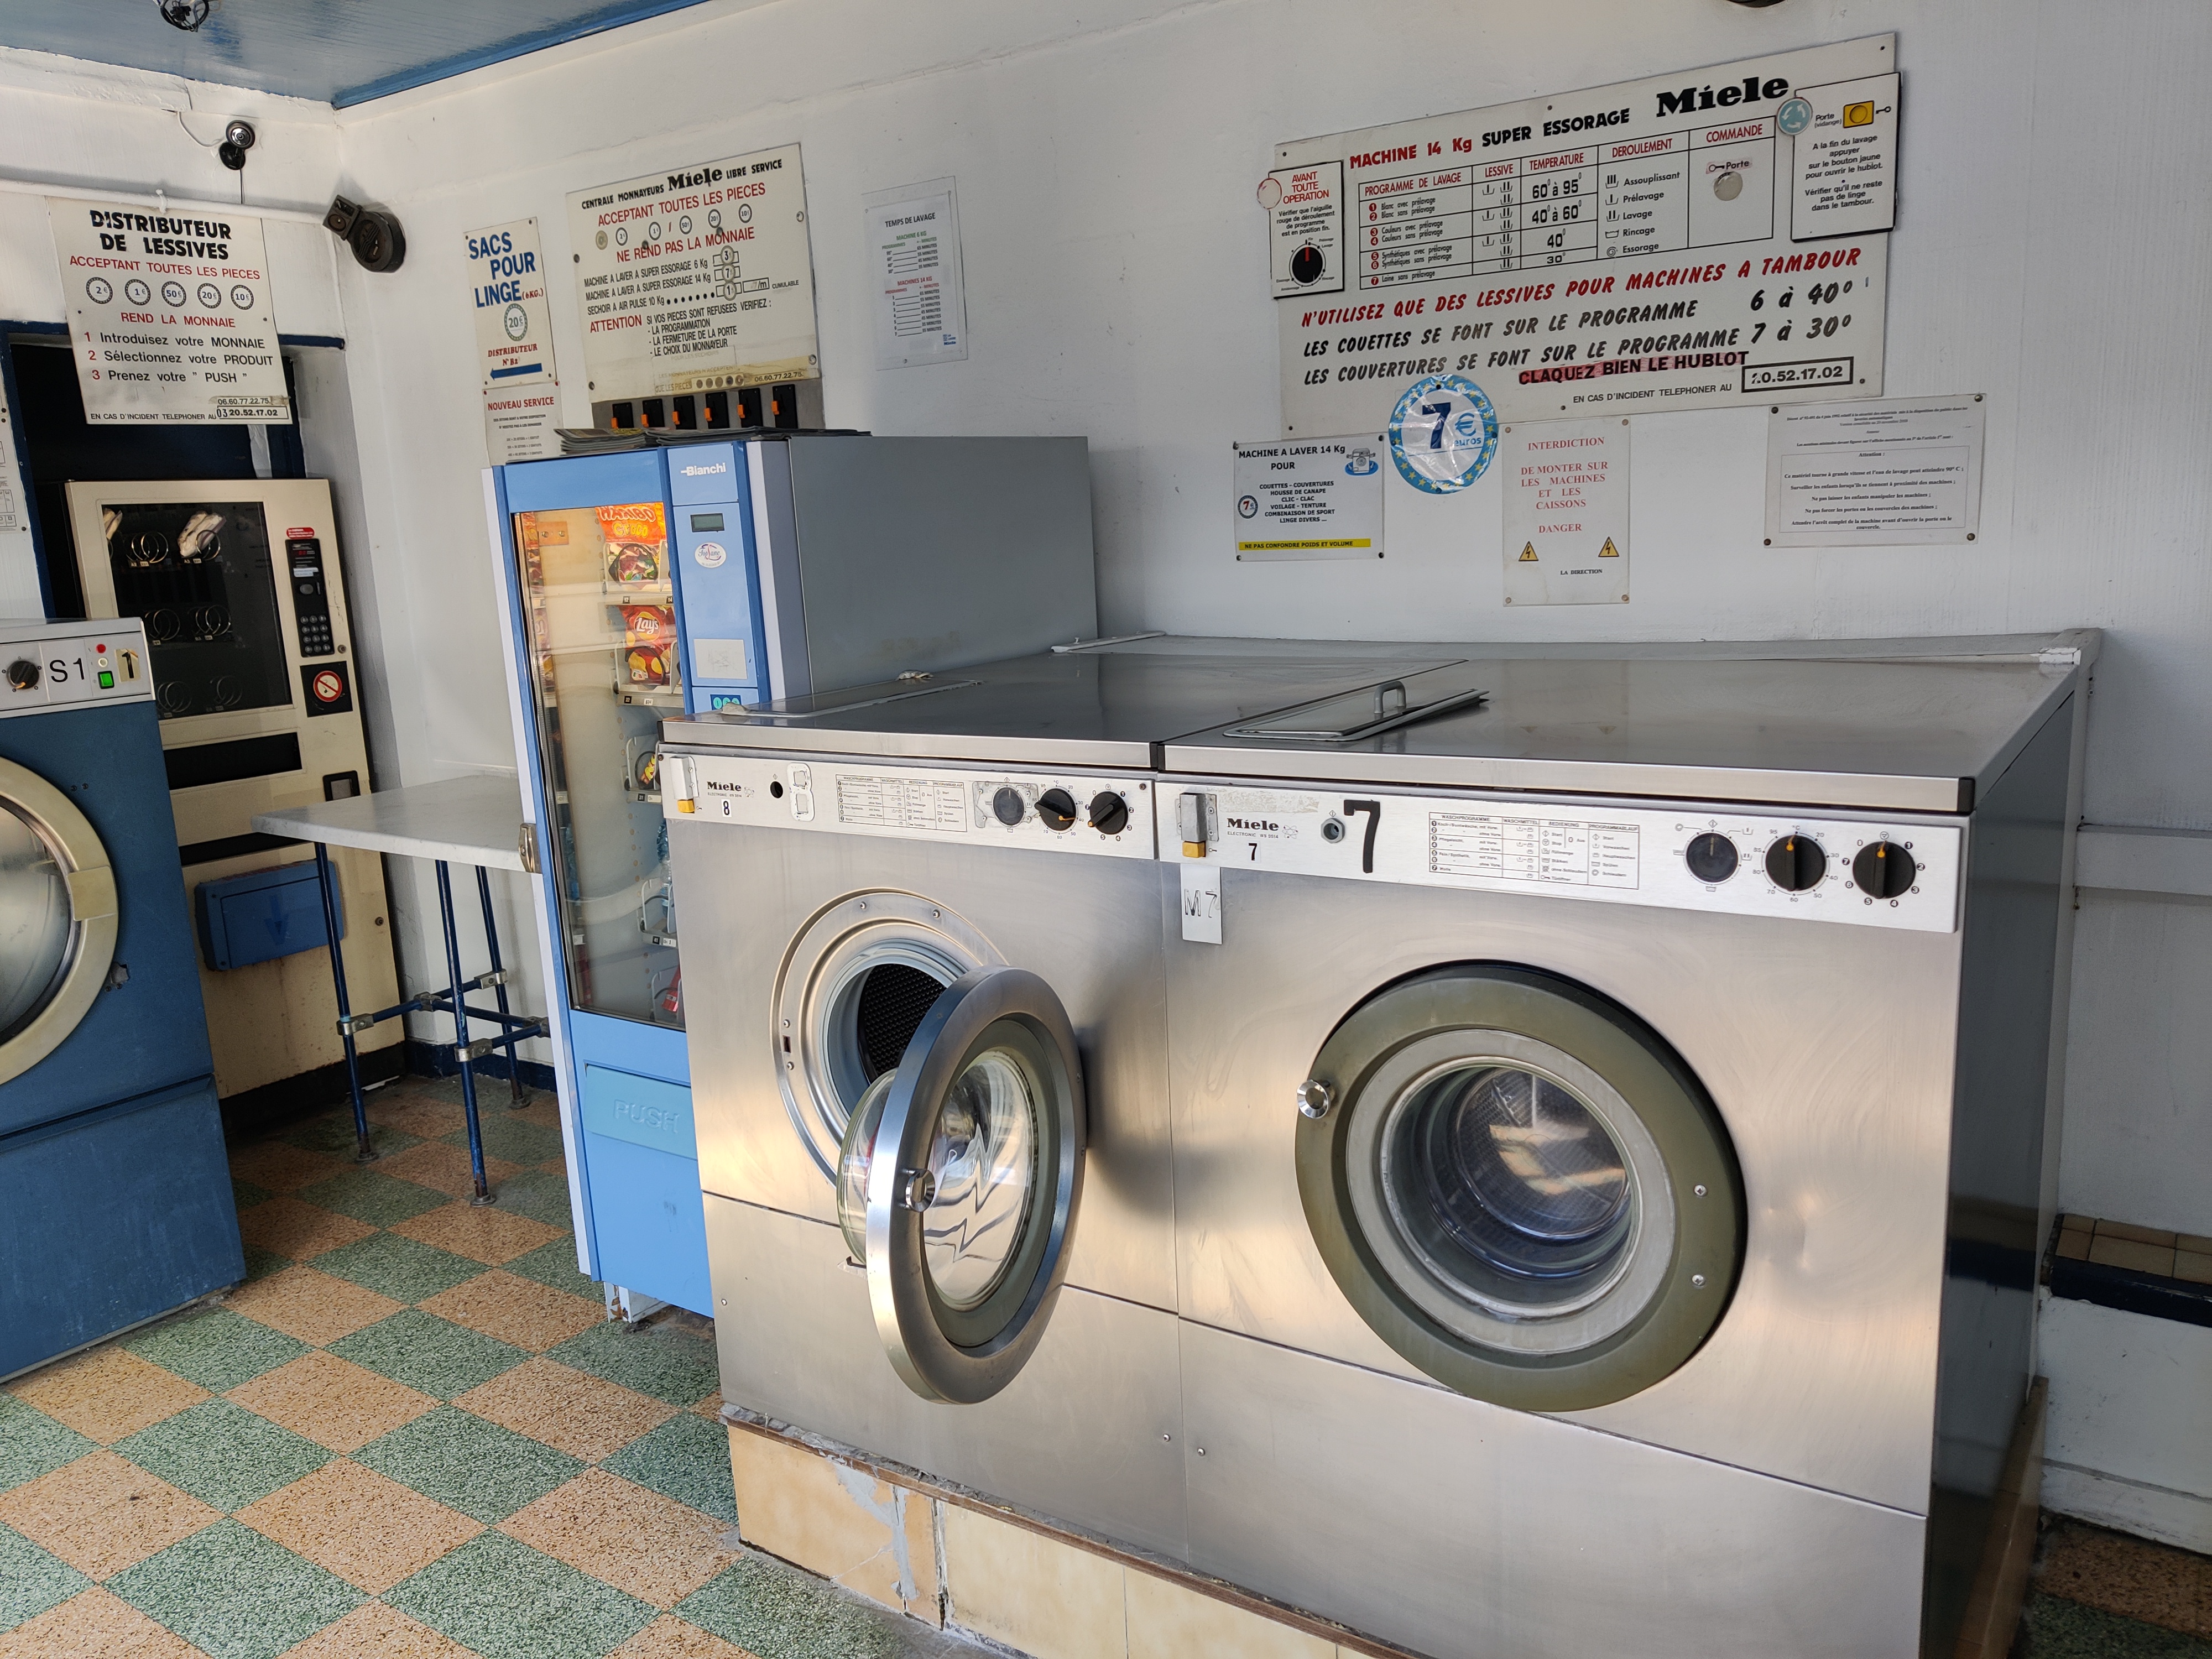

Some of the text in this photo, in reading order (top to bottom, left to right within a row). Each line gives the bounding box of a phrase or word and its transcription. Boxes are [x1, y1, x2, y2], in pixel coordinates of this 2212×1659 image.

[1656, 76, 1789, 118] Miele
[1350, 108, 1629, 169] MACHINE 14 Kg SUPER ESSORAGE
[1706, 124, 1762, 143] COMMANDE
[1852, 134, 1878, 145] lavage
[1612, 138, 1673, 158] DEROULEMENT
[1829, 147, 1860, 157] appuyer
[1530, 153, 1584, 171] TEMPERATURE
[1726, 159, 1749, 170] Porte
[1292, 171, 1318, 183] AVANT
[1485, 164, 1514, 178] LESSIVE
[1623, 171, 1681, 186] Assouplissant
[582, 159, 782, 210] CENTRALE MONNAYEURS Miele LIBRE SERVICE
[1291, 181, 1319, 193] TOUTE
[1365, 172, 1462, 196] PROGRAMME DE LAVAGE
[598, 182, 766, 227] ACCEPTANT TOUTES LES PIECES
[1283, 190, 1329, 204] OPERATION
[1623, 191, 1665, 204] Prélavage
[885, 218, 904, 228] TEMPS
[914, 212, 936, 223] LAVAGE
[1623, 210, 1652, 220] Lavage
[90, 210, 232, 239] DISTRIBUTEUR
[1623, 226, 1655, 237] Rincage
[100, 233, 229, 259] DE LESSIVES
[468, 232, 512, 260] SACS
[617, 226, 755, 263] NE REND PAS LA MONNAIE
[1623, 243, 1659, 253] Essorage
[70, 255, 260, 280] ACCEPTANT TOUTES LES PIECES
[490, 252, 536, 280] POUR
[474, 280, 522, 308] LINGE
[1302, 248, 1861, 327] N'UTILISEZ QUE DES LESSIVES POUR MACHINES A TAMBOUR
[121, 312, 236, 327] REND LA MONNAIE
[589, 315, 642, 333] ATTENTION
[1303, 341, 1328, 357] LES
[1337, 331, 1411, 353] COUETTES
[1421, 327, 1442, 344] SE
[1451, 322, 1493, 341] FONT
[1503, 317, 1539, 336] SUR
[1549, 314, 1568, 331] LE
[1578, 300, 1698, 328] PROGRAMME
[1750, 289, 1765, 310] 6
[1778, 286, 1793, 308] à
[85, 332, 265, 349] 1 Introduisez votre MONNAIE
[88, 349, 273, 366] 2 Sélectionnez votre PRODUIT
[488, 343, 538, 357] DISTRIBUTEUR
[1519, 351, 1749, 385] CLAQUEZ BIEN LE HUBLOT
[488, 397, 555, 411] NOUVEAU SERVICE
[1422, 402, 1452, 450] 7
[1239, 448, 1279, 458] MACHINE
[1290, 447, 1317, 456] LAVER
[1334, 445, 1345, 454] Kg
[1528, 437, 1605, 451] INTERDICTION
[687, 463, 726, 476] Bianchi
[1521, 461, 1609, 475] DE MONTER SUR
[1521, 473, 1605, 487] LES MACHINES
[1538, 487, 1581, 498] ET LES
[1536, 499, 1586, 509] CAISSONS
[1538, 523, 1582, 534] DANGER
[49, 659, 85, 682] S1
[122, 652, 134, 679] 1
[707, 781, 742, 791] Miele
[787, 763, 815, 822] 8
[723, 801, 730, 816] 8
[1227, 818, 1279, 831] Miele
[1343, 799, 1381, 873] 7
[1248, 843, 1258, 861] 7
[613, 1100, 680, 1134] PUSH
